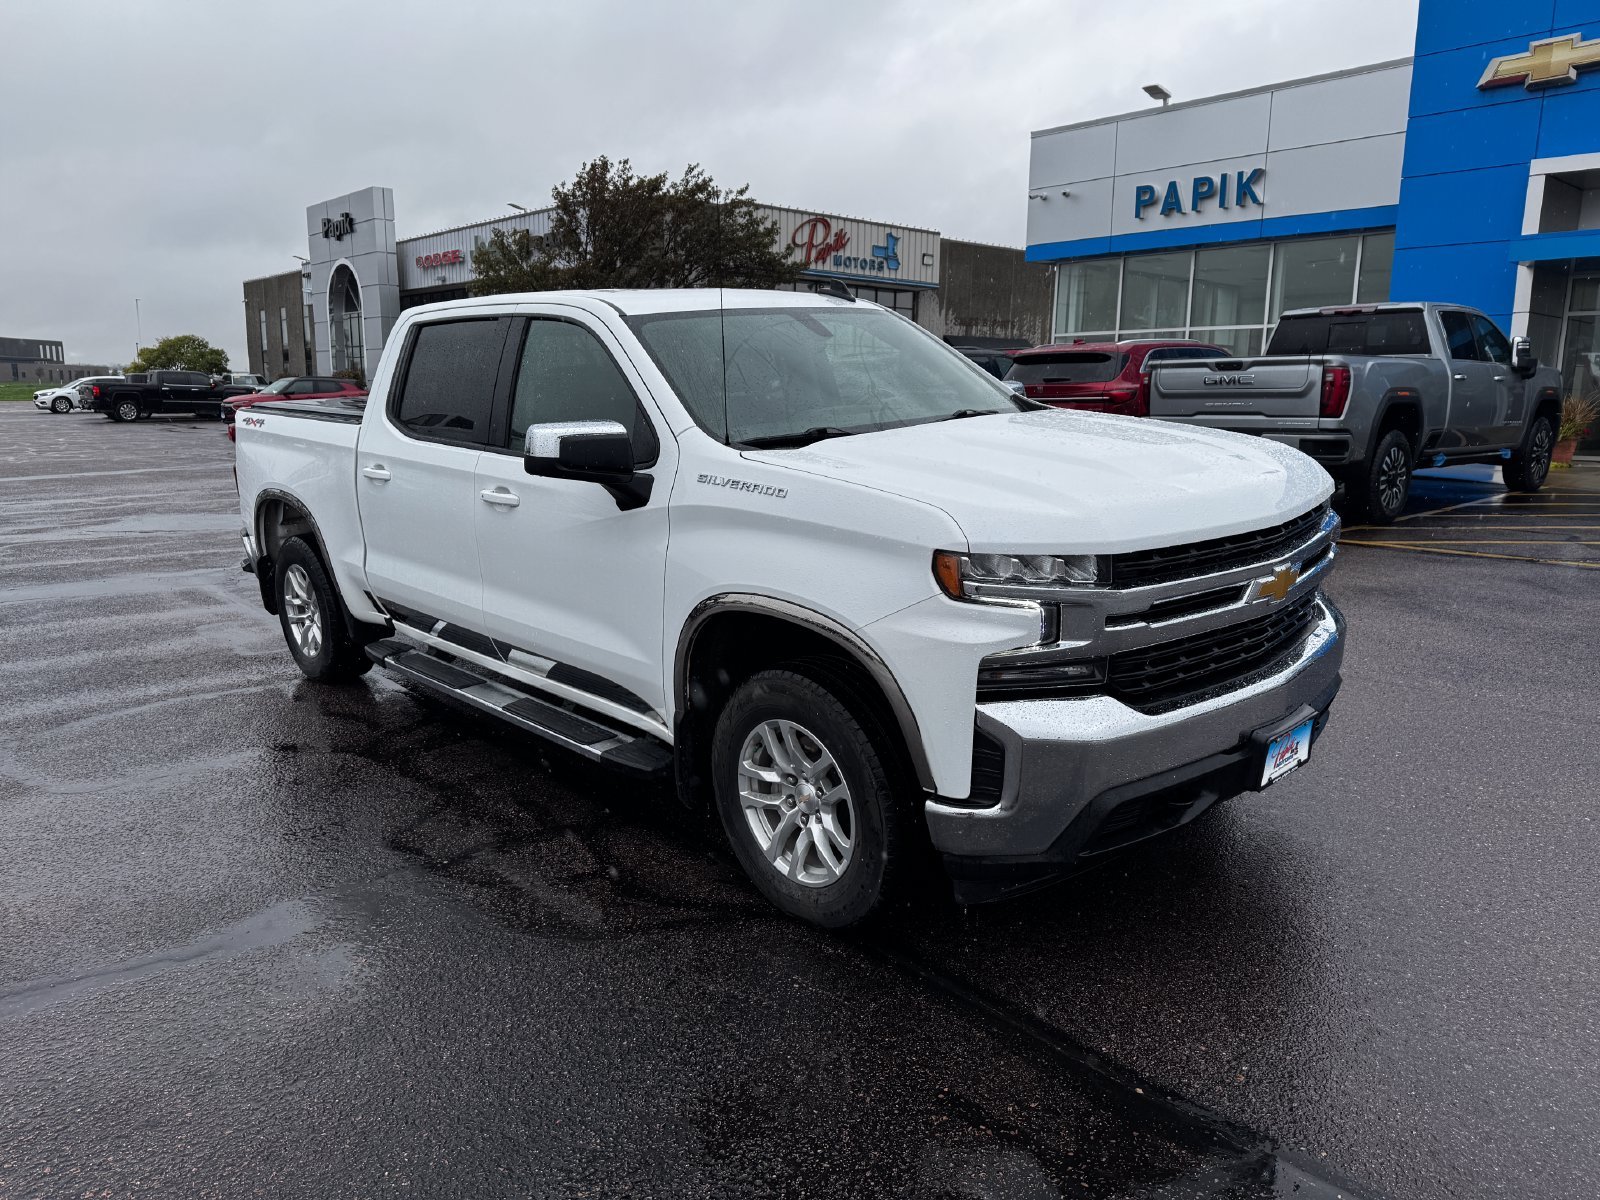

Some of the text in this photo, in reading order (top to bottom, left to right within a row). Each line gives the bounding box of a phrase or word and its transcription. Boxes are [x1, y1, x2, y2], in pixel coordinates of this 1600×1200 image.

[1135, 168, 1265, 219] PAPIK
[321, 212, 354, 241] Papik
[415, 249, 465, 269] DODGE
[833, 254, 884, 272] MOTORS
[1203, 374, 1255, 386] GMC
[697, 473, 789, 499] SILVERADO
